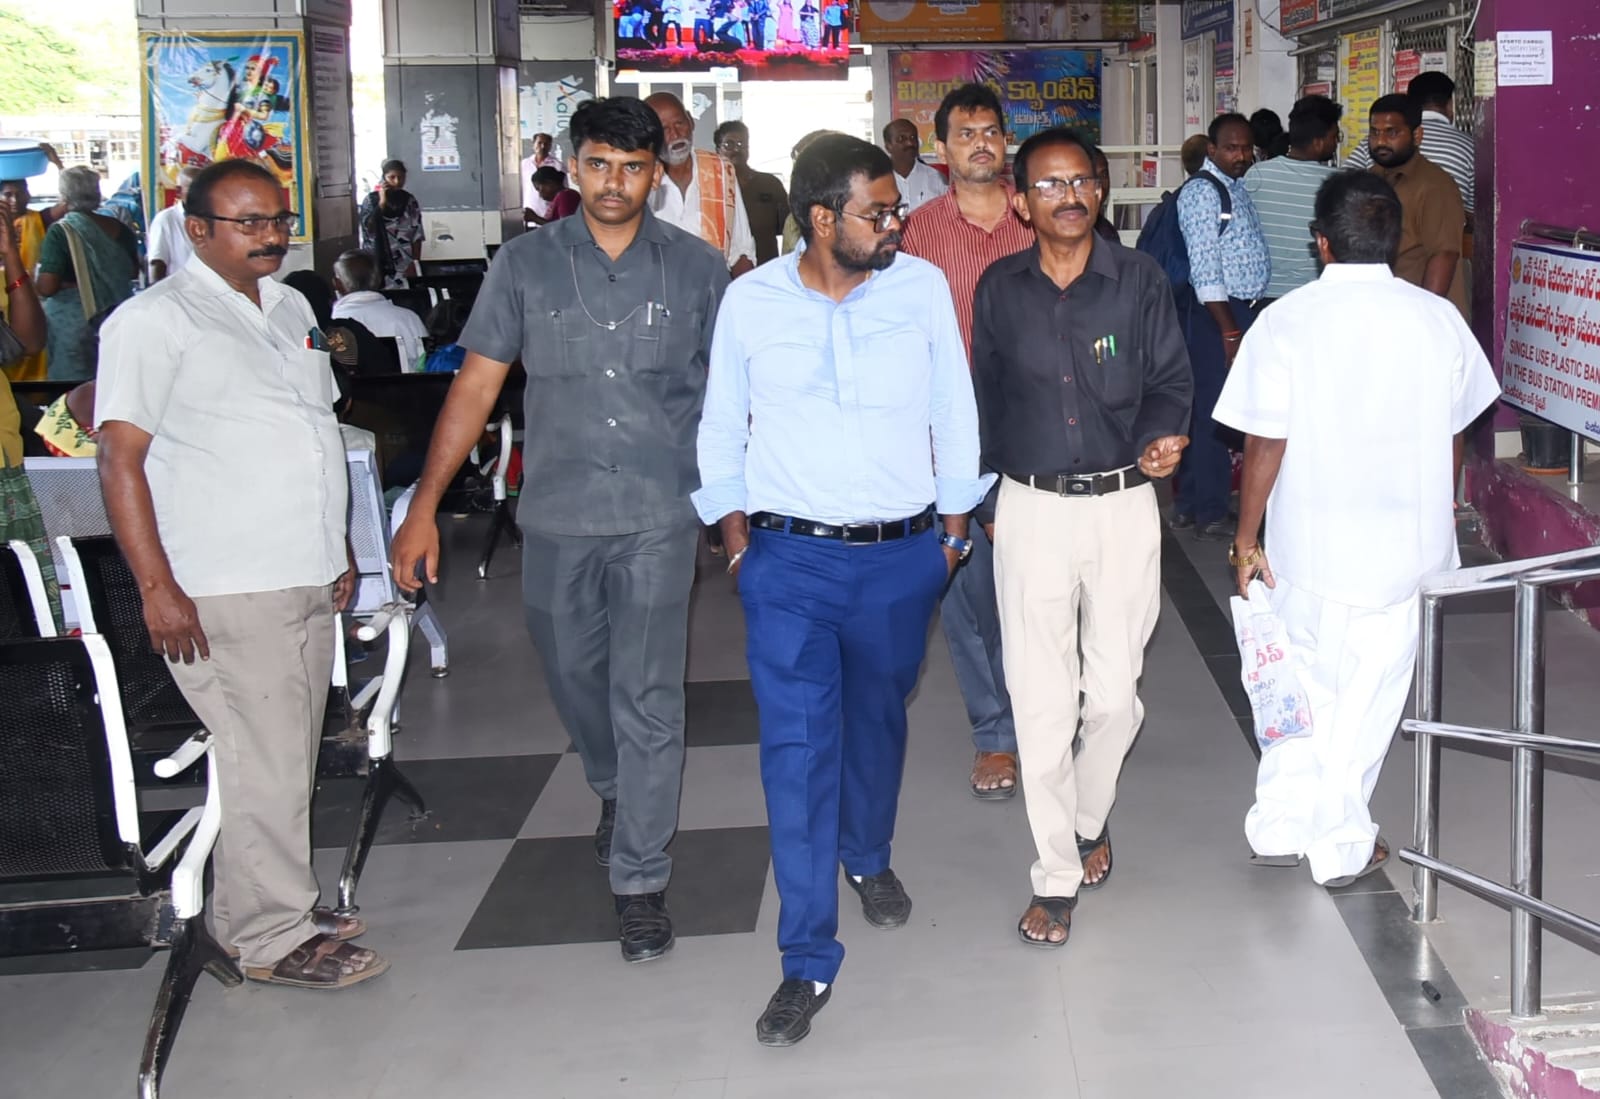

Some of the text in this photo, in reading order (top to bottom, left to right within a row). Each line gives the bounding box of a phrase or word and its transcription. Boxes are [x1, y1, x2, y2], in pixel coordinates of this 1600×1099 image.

[1509, 339, 1534, 361] SINGLE
[1535, 347, 1550, 367] USE
[1551, 353, 1582, 378] PLASTIC
[1505, 360, 1513, 377] IN
[1514, 363, 1527, 383] THE
[1528, 369, 1543, 388] BUS
[1544, 375, 1574, 401] STATION
